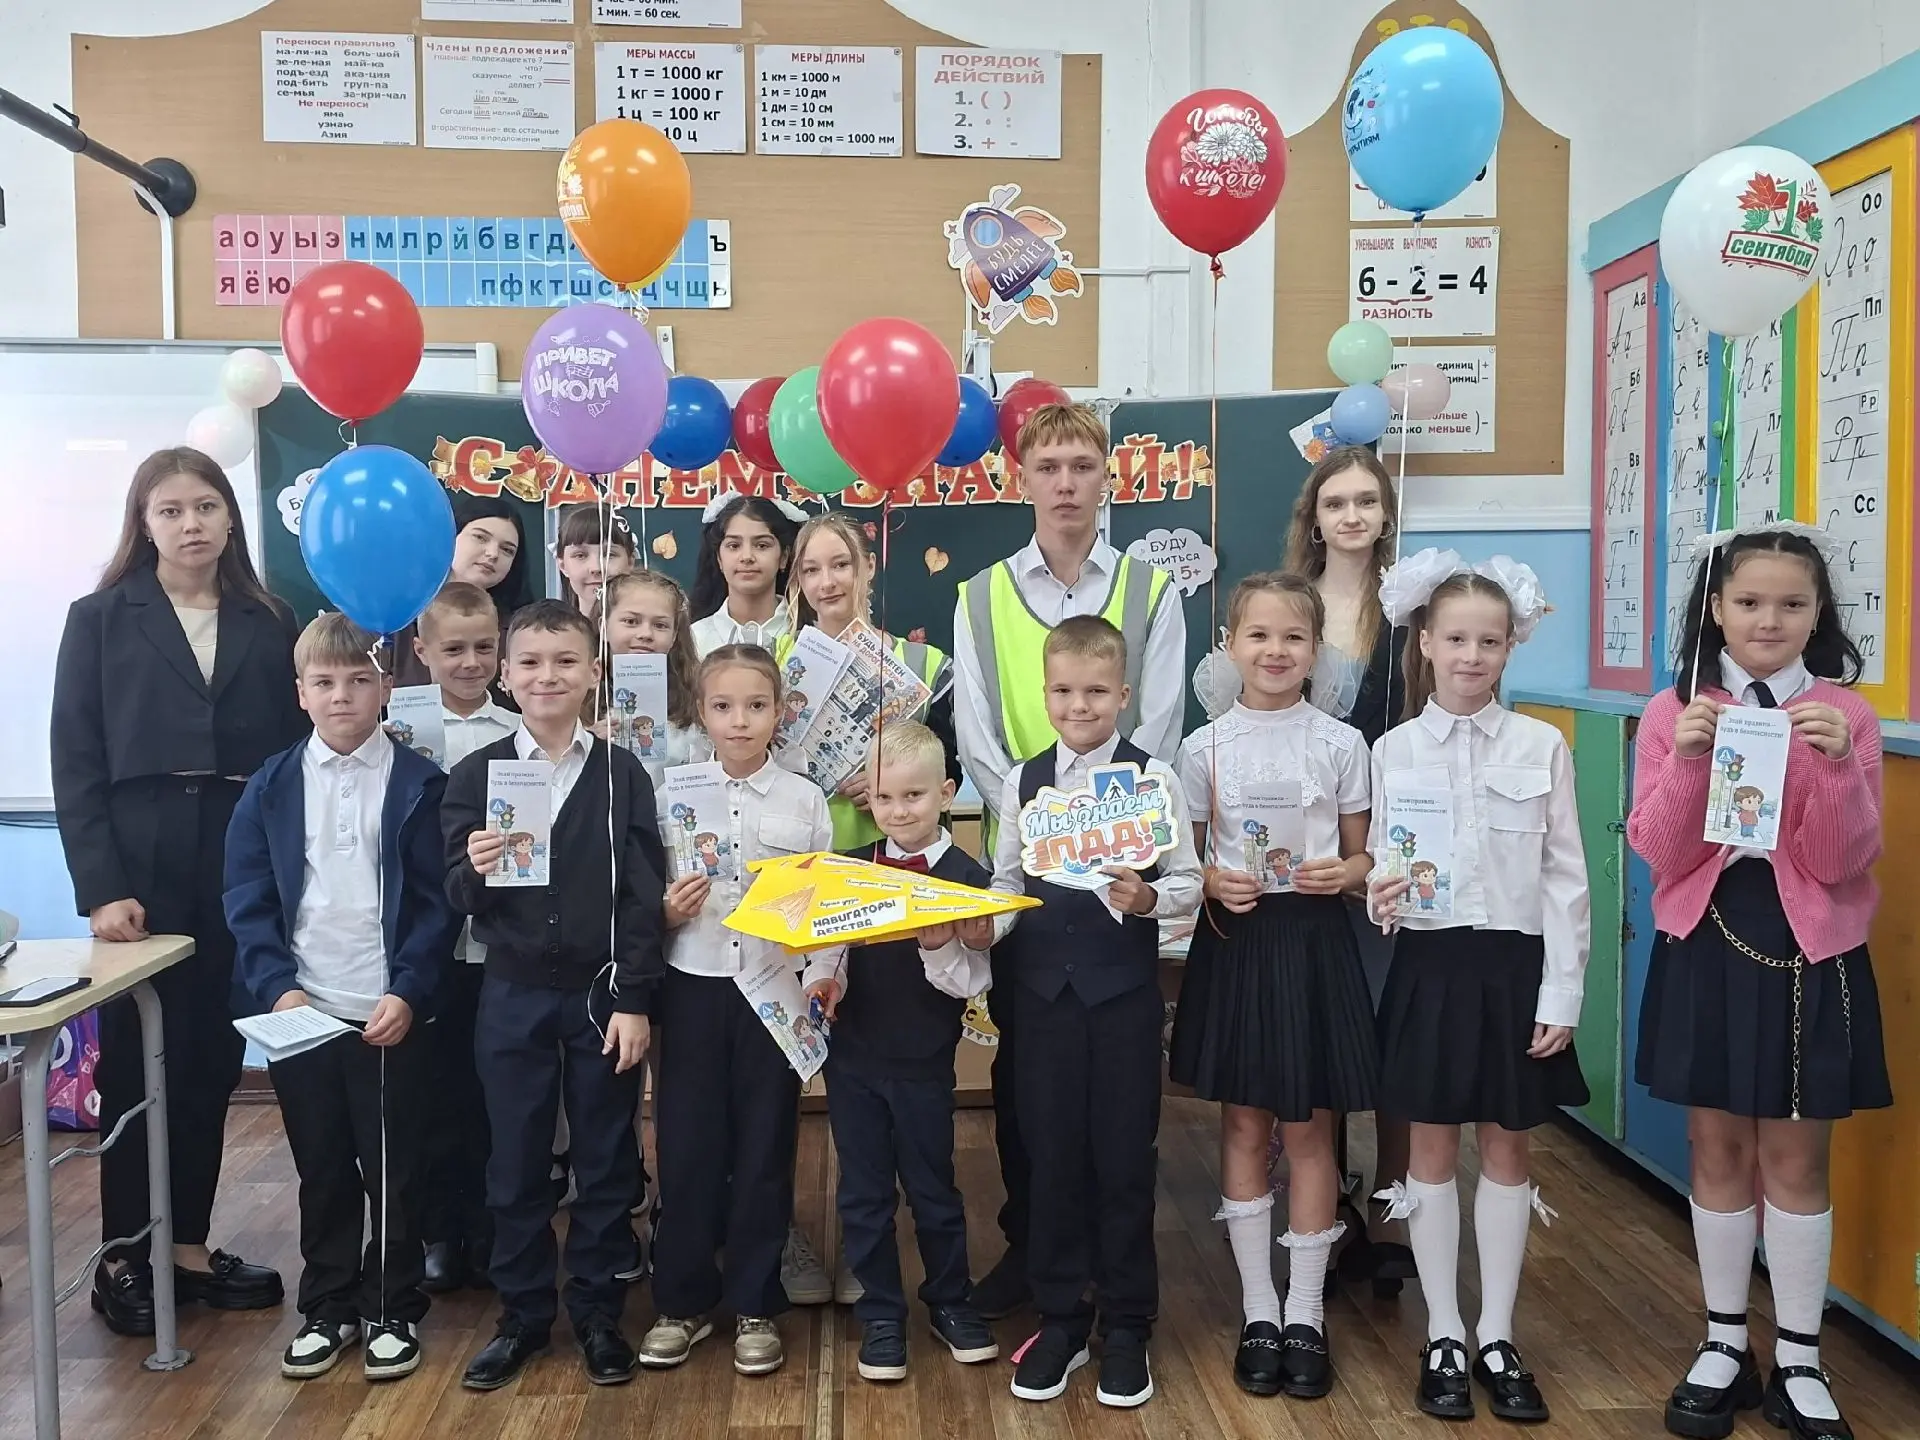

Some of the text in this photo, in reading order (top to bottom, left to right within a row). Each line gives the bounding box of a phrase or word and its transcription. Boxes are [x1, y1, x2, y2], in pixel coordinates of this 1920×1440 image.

[597, 7, 603, 16] 1
[607, 9, 631, 17] мин.
[645, 8, 658, 18] 60
[660, 10, 681, 19] сек.
[276, 37, 396, 48] Переноси правильно
[427, 42, 568, 55] Члены предложения
[276, 48, 328, 56] ма-ли-на
[344, 48, 400, 58] боль-шой
[626, 49, 695, 60] МЕРЫ МАССЫ
[276, 58, 331, 67] зе-ле-ная
[344, 59, 385, 68] май-ка
[791, 53, 865, 65] МЕРЫ ДЛИНЫ
[940, 54, 1041, 69] ПОРЯДОК
[276, 69, 329, 78] подъ-езд
[344, 70, 390, 79] ака-ция
[616, 66, 624, 79] 1
[630, 69, 639, 79] т
[662, 66, 701, 80] 1000
[706, 70, 724, 80] кг
[761, 72, 767, 81] 1
[801, 73, 829, 83] 1000
[832, 75, 841, 83] м
[934, 70, 1045, 84] ДЕЙСТВИЙ
[277, 78, 328, 87] под-бить
[344, 81, 389, 90] груп-па
[277, 89, 315, 97] се-мья
[343, 91, 407, 100] за-кри-чал
[617, 86, 625, 99] 1
[631, 90, 648, 100] кг
[671, 87, 710, 100] 1000
[715, 90, 724, 100] г
[761, 87, 767, 97] 1
[795, 88, 808, 97] 10
[811, 90, 827, 100] дм
[954, 91, 973, 105] 1.
[316, 101, 369, 109] переноси
[761, 103, 767, 112] 1
[771, 105, 787, 115] дм
[802, 103, 815, 113] 10
[819, 105, 833, 113] см
[617, 106, 625, 119] 1
[631, 109, 642, 122] ц
[669, 107, 698, 120] 100
[704, 110, 721, 121] кг
[954, 113, 973, 127] 2.
[318, 121, 353, 129] узнаю
[761, 118, 767, 127] 1
[771, 120, 785, 128] см
[800, 118, 814, 128] 10
[321, 131, 348, 139] Азия
[687, 130, 698, 142] ц
[761, 133, 768, 142] 1
[795, 133, 815, 143] 100
[847, 134, 875, 144] 1000
[878, 136, 895, 144] мм
[954, 135, 973, 149] 3.
[1771, 180, 1800, 239] 1
[1355, 238, 1394, 251] УМЕНЬШАЕМОЕ
[1465, 236, 1492, 249] РАЗНОСТЬ
[988, 235, 1024, 270] БУДЬ
[993, 240, 1046, 290] СМЕЛЕЕ
[1358, 266, 1376, 296] 6
[1410, 265, 1427, 295] 2
[1469, 265, 1488, 295] 4
[1362, 308, 1433, 319] РАЗНОСТЬ
[1436, 361, 1474, 371] единиц
[533, 370, 619, 402] ШКОЛА
[1428, 424, 1472, 433] меньше
[453, 437, 503, 498] С
[1150, 537, 1188, 553] БУДУ
[857, 632, 876, 652] БУДЬ
[859, 646, 884, 667] ДОРОГ
[1026, 791, 1166, 838] Мы знаем
[1048, 818, 1154, 865] ПДД!
[813, 899, 896, 928] НАВИГАТОРЫ
[816, 918, 873, 937] ДЕТСТВА
